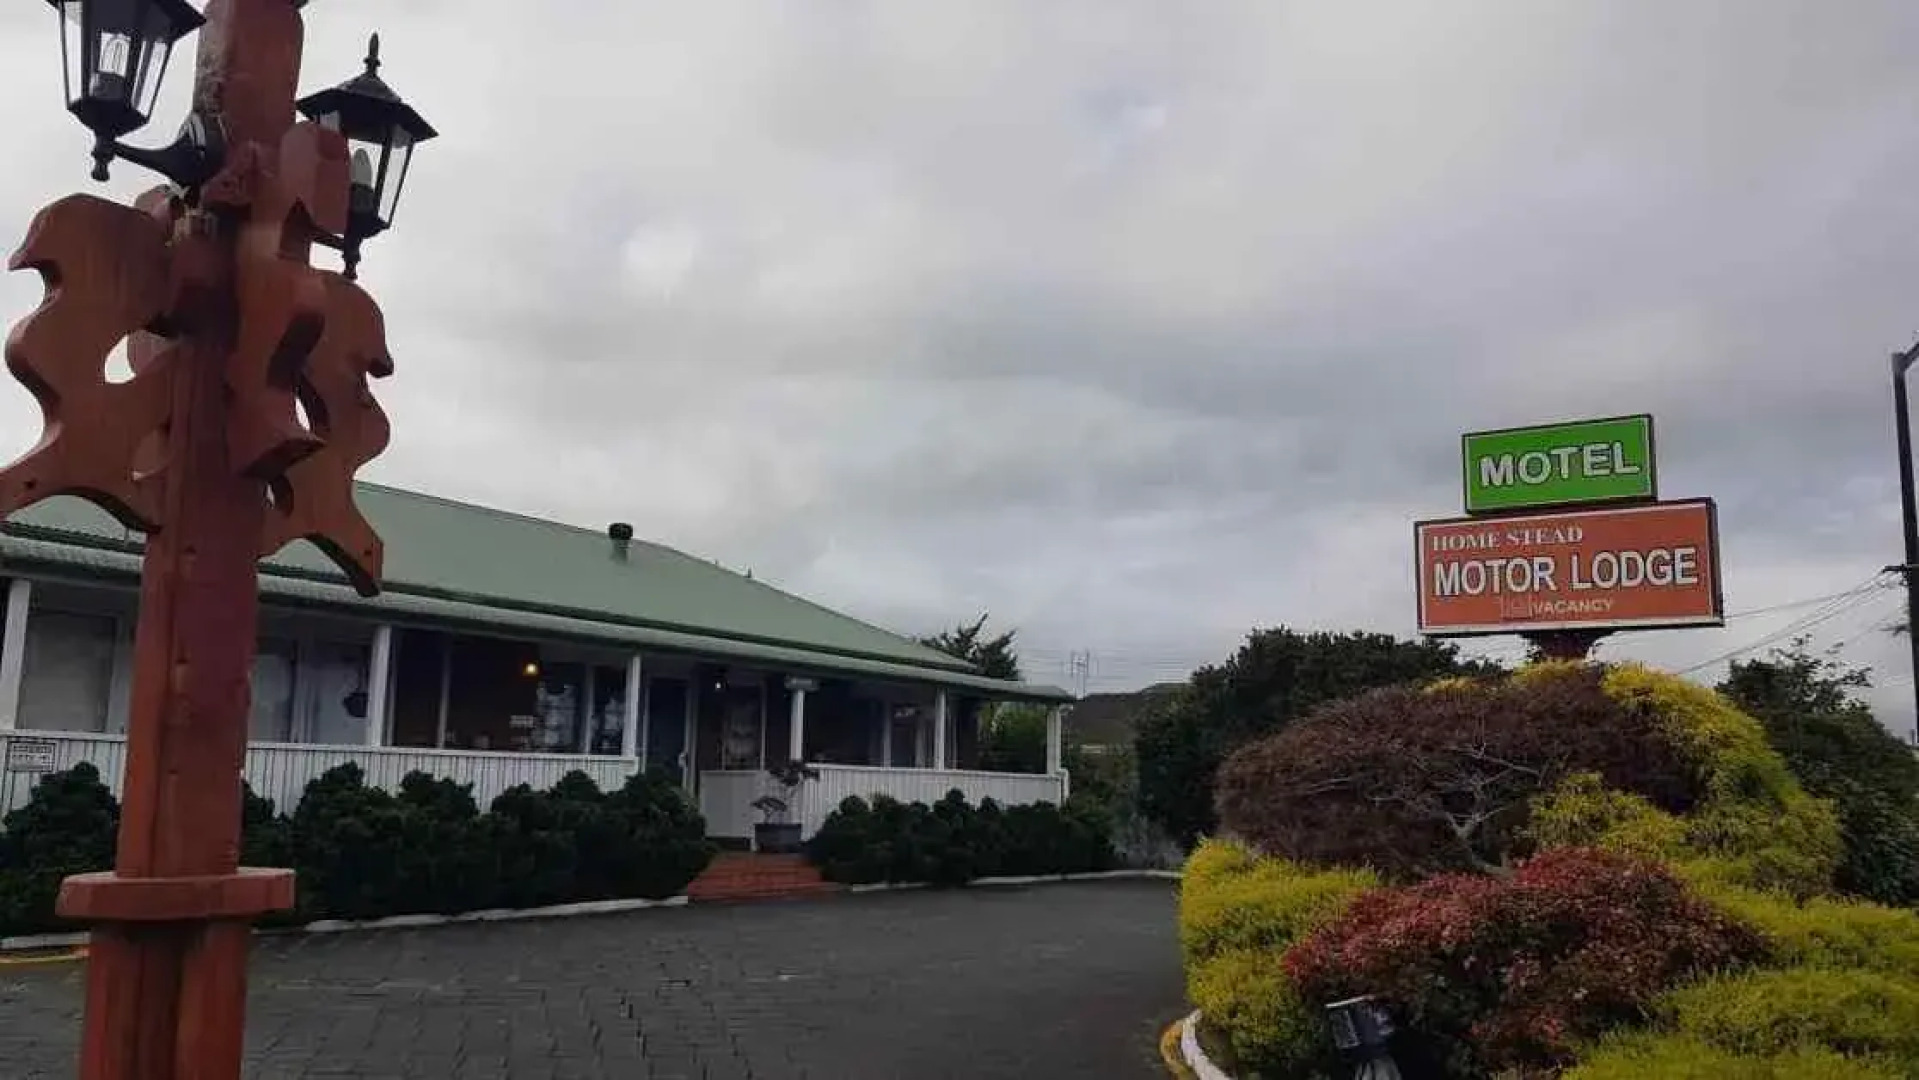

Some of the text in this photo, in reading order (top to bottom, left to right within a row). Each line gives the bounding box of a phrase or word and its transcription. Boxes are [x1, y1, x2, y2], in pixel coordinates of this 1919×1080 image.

[1479, 442, 1639, 486] MOTEL
[1432, 526, 1583, 551] HOME STEAD
[1434, 547, 1698, 596] MOTOR LODGE
[1533, 598, 1612, 613] VACANCY
